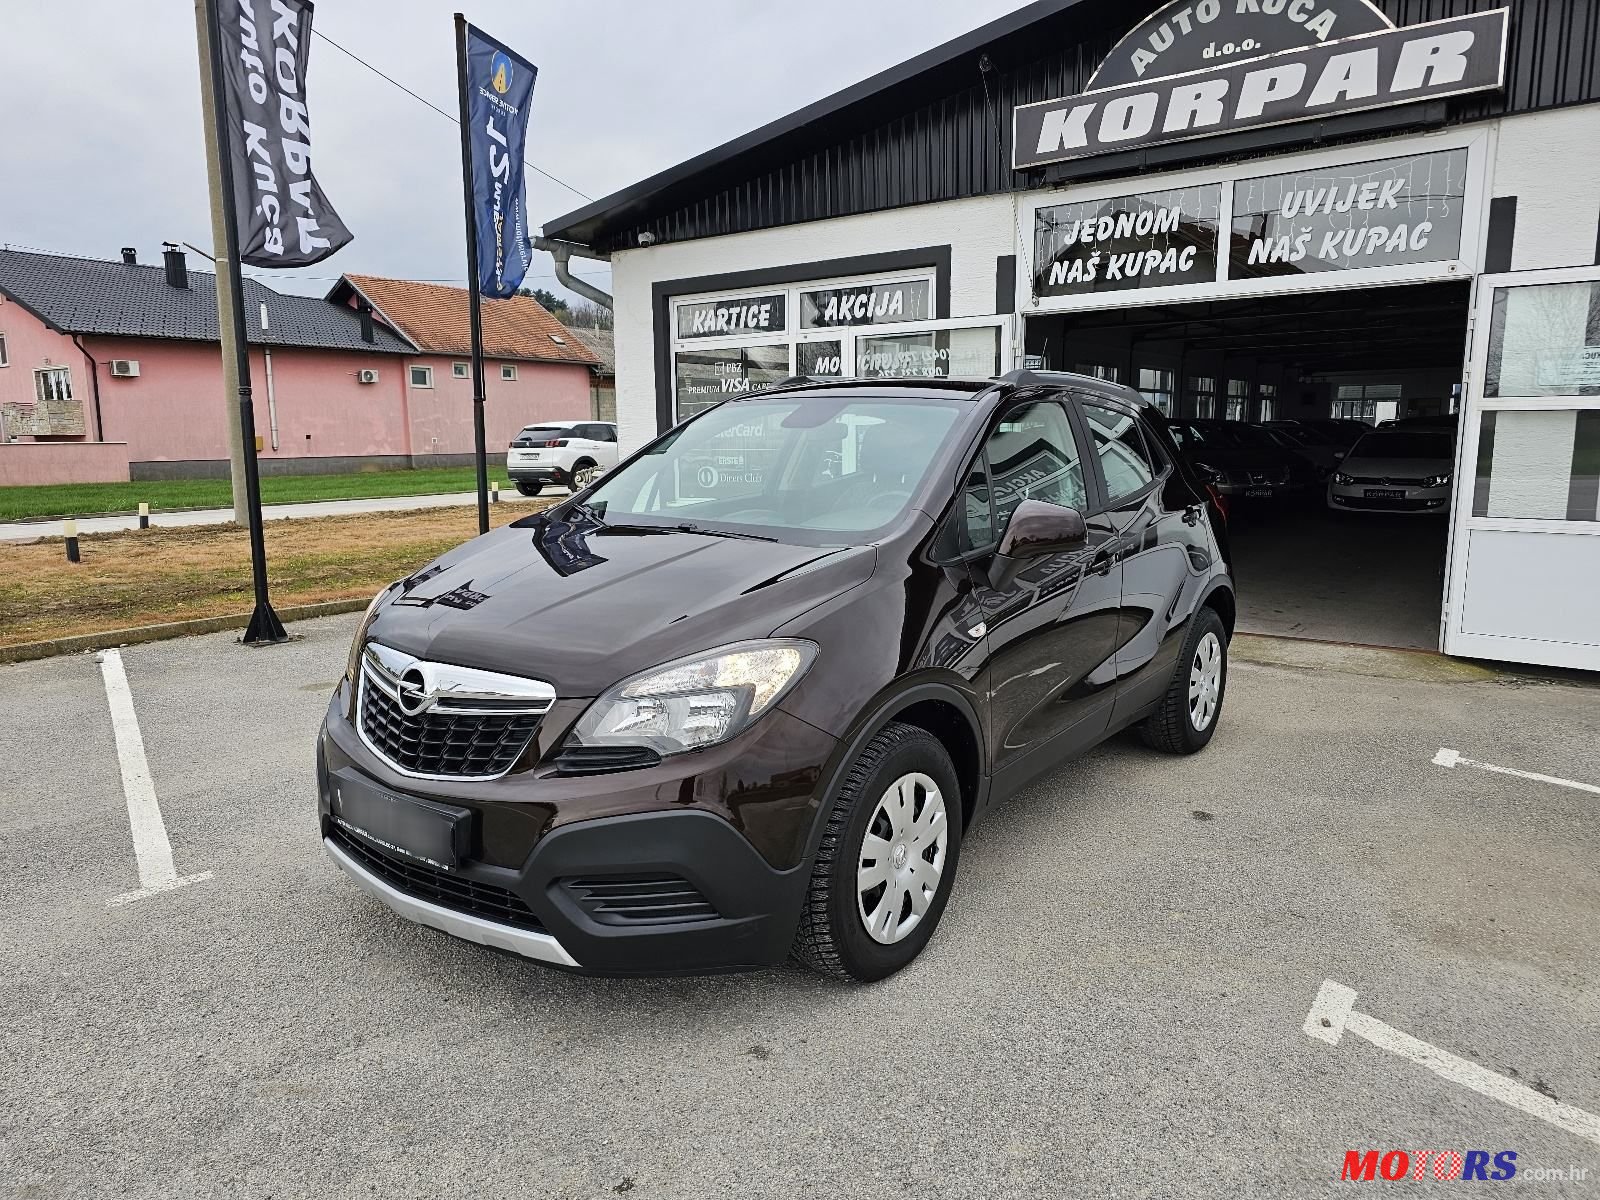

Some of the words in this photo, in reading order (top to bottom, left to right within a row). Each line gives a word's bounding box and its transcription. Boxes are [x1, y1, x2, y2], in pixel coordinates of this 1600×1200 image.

[1131, 0, 1220, 77] AUTO
[1202, 38, 1261, 59] d.o.o.
[1036, 30, 1476, 154] KORPAR
[1281, 178, 1406, 219] UVIJEK
[1064, 207, 1181, 245] JEDNOM
[1247, 229, 1316, 266] NAŠ
[1319, 220, 1433, 261] KUPAC
[1049, 250, 1101, 286] NAŠ
[1105, 244, 1197, 280] KUPAC
[692, 304, 771, 333] KARTICE
[824, 290, 903, 322] AKCIJA
[689, 385, 720, 394] PREMIUM
[721, 378, 750, 393] VISA
[726, 363, 742, 373] PBZ
